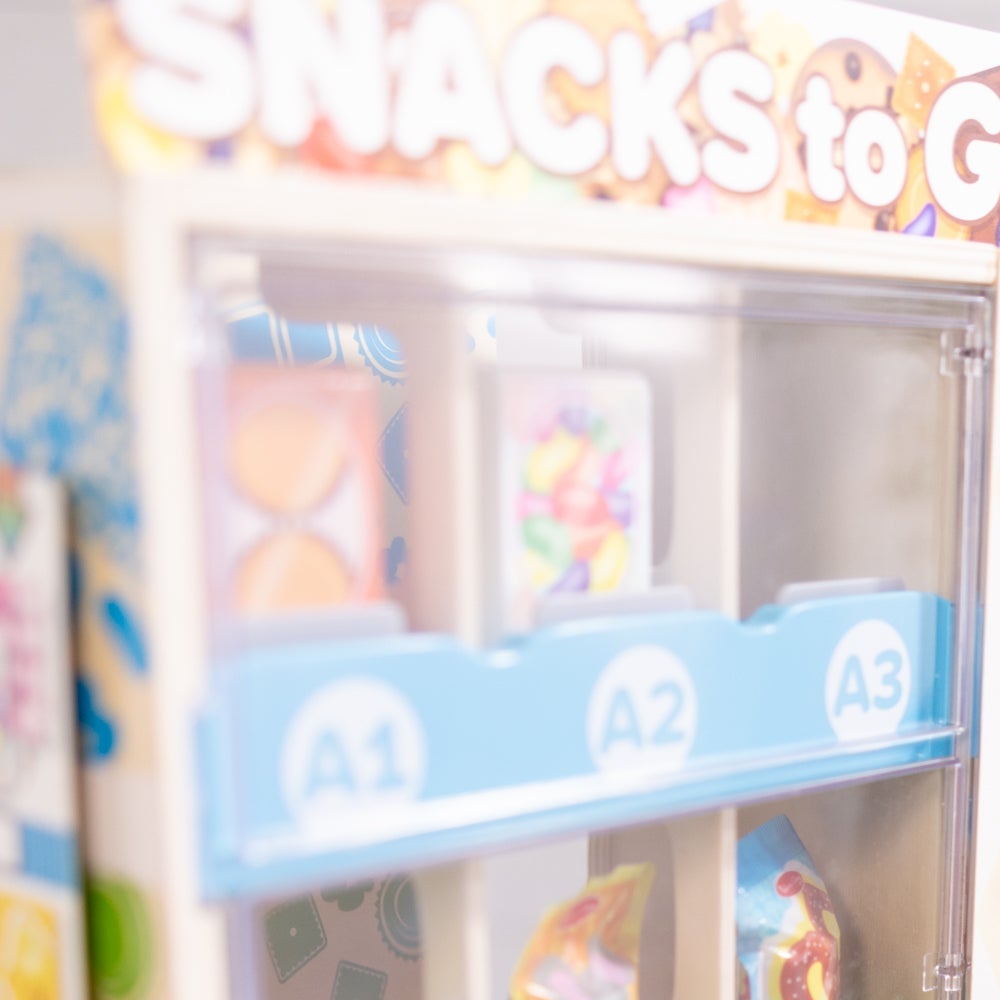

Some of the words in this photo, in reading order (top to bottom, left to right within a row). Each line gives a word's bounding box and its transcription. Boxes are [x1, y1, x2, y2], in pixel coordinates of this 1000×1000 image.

[118, 0, 779, 193] SNACKS
[797, 74, 908, 206] to
[600, 682, 686, 752] A2
[833, 648, 905, 717] A3
[306, 722, 407, 796] A1
